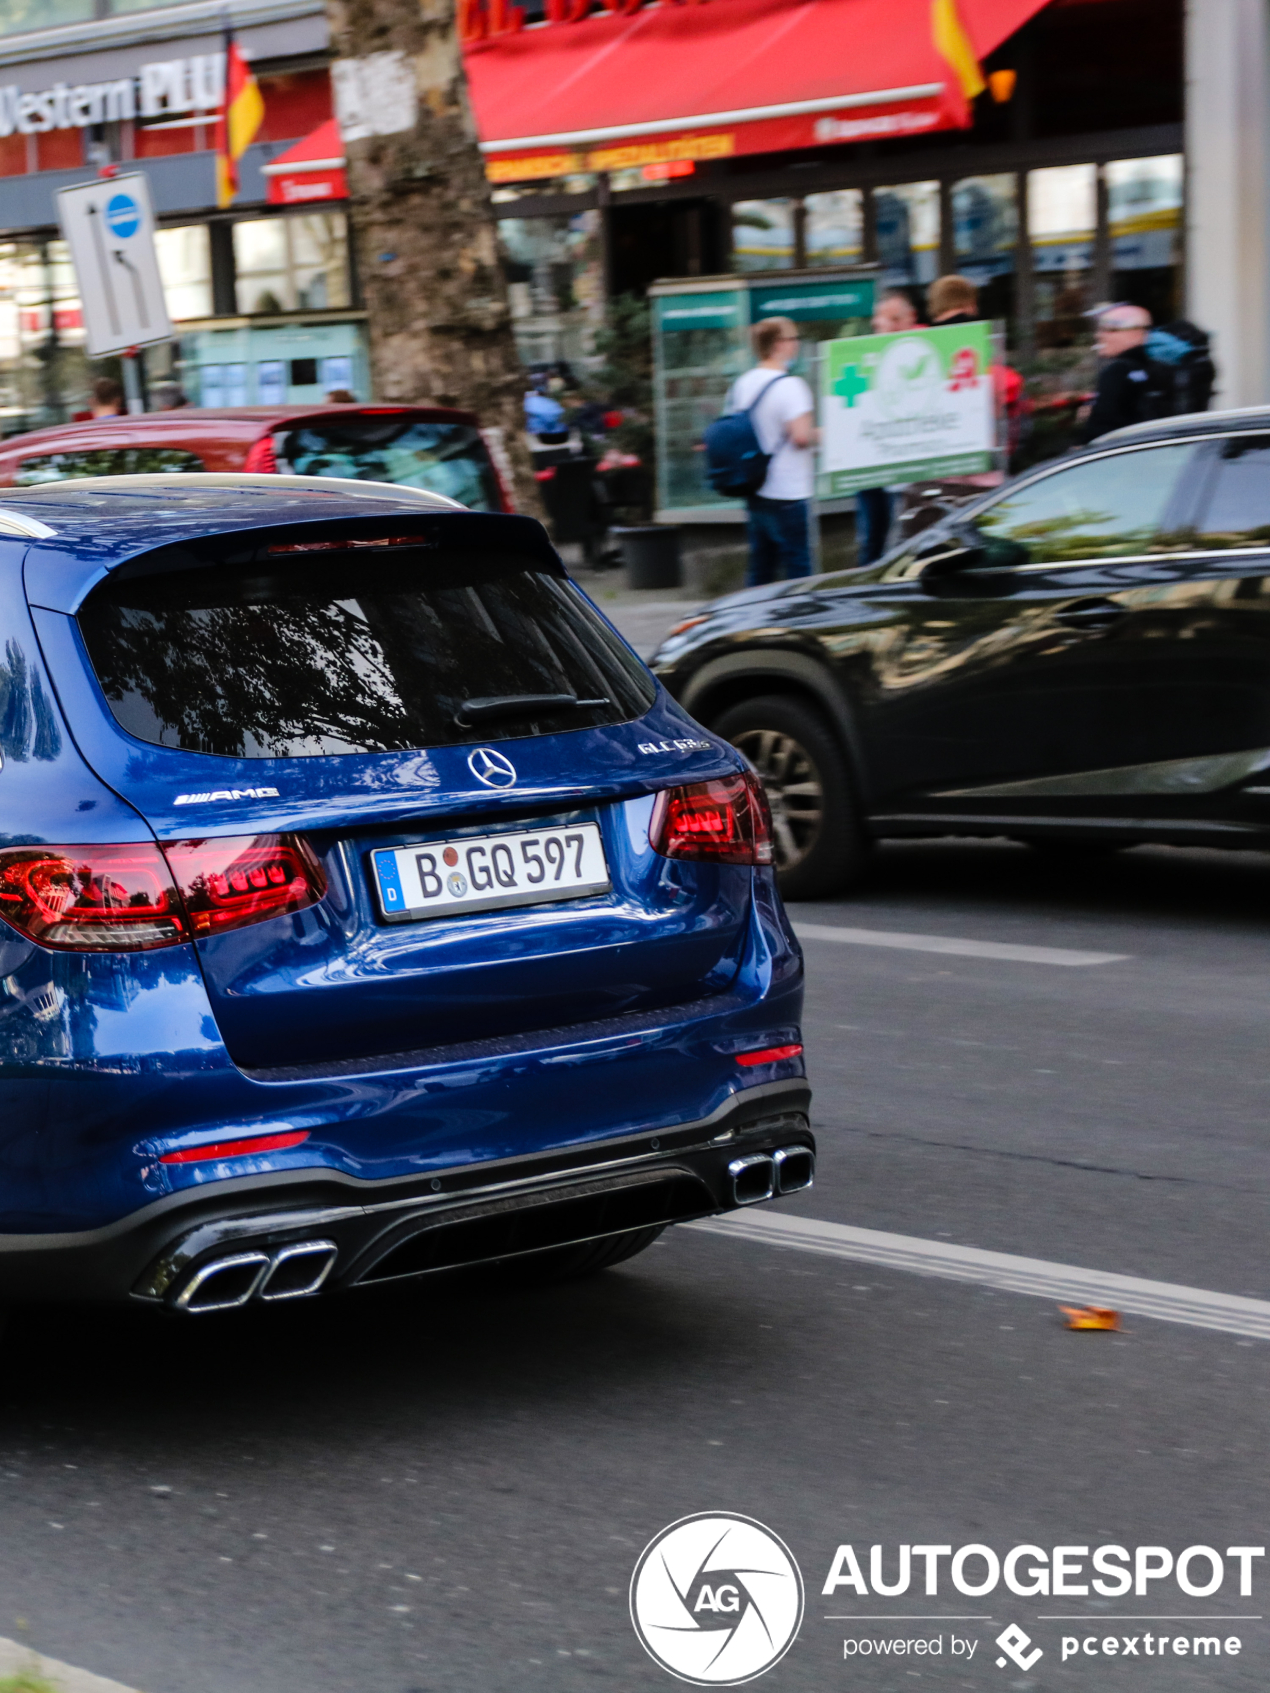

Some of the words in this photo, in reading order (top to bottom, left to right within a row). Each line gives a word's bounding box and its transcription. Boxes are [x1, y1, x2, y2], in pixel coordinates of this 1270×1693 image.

[637, 741, 676, 755] GLC
[208, 787, 281, 802] AMG
[415, 852, 443, 899] B
[466, 843, 518, 891] GQ
[520, 833, 584, 884] 597
[386, 887, 398, 902] D
